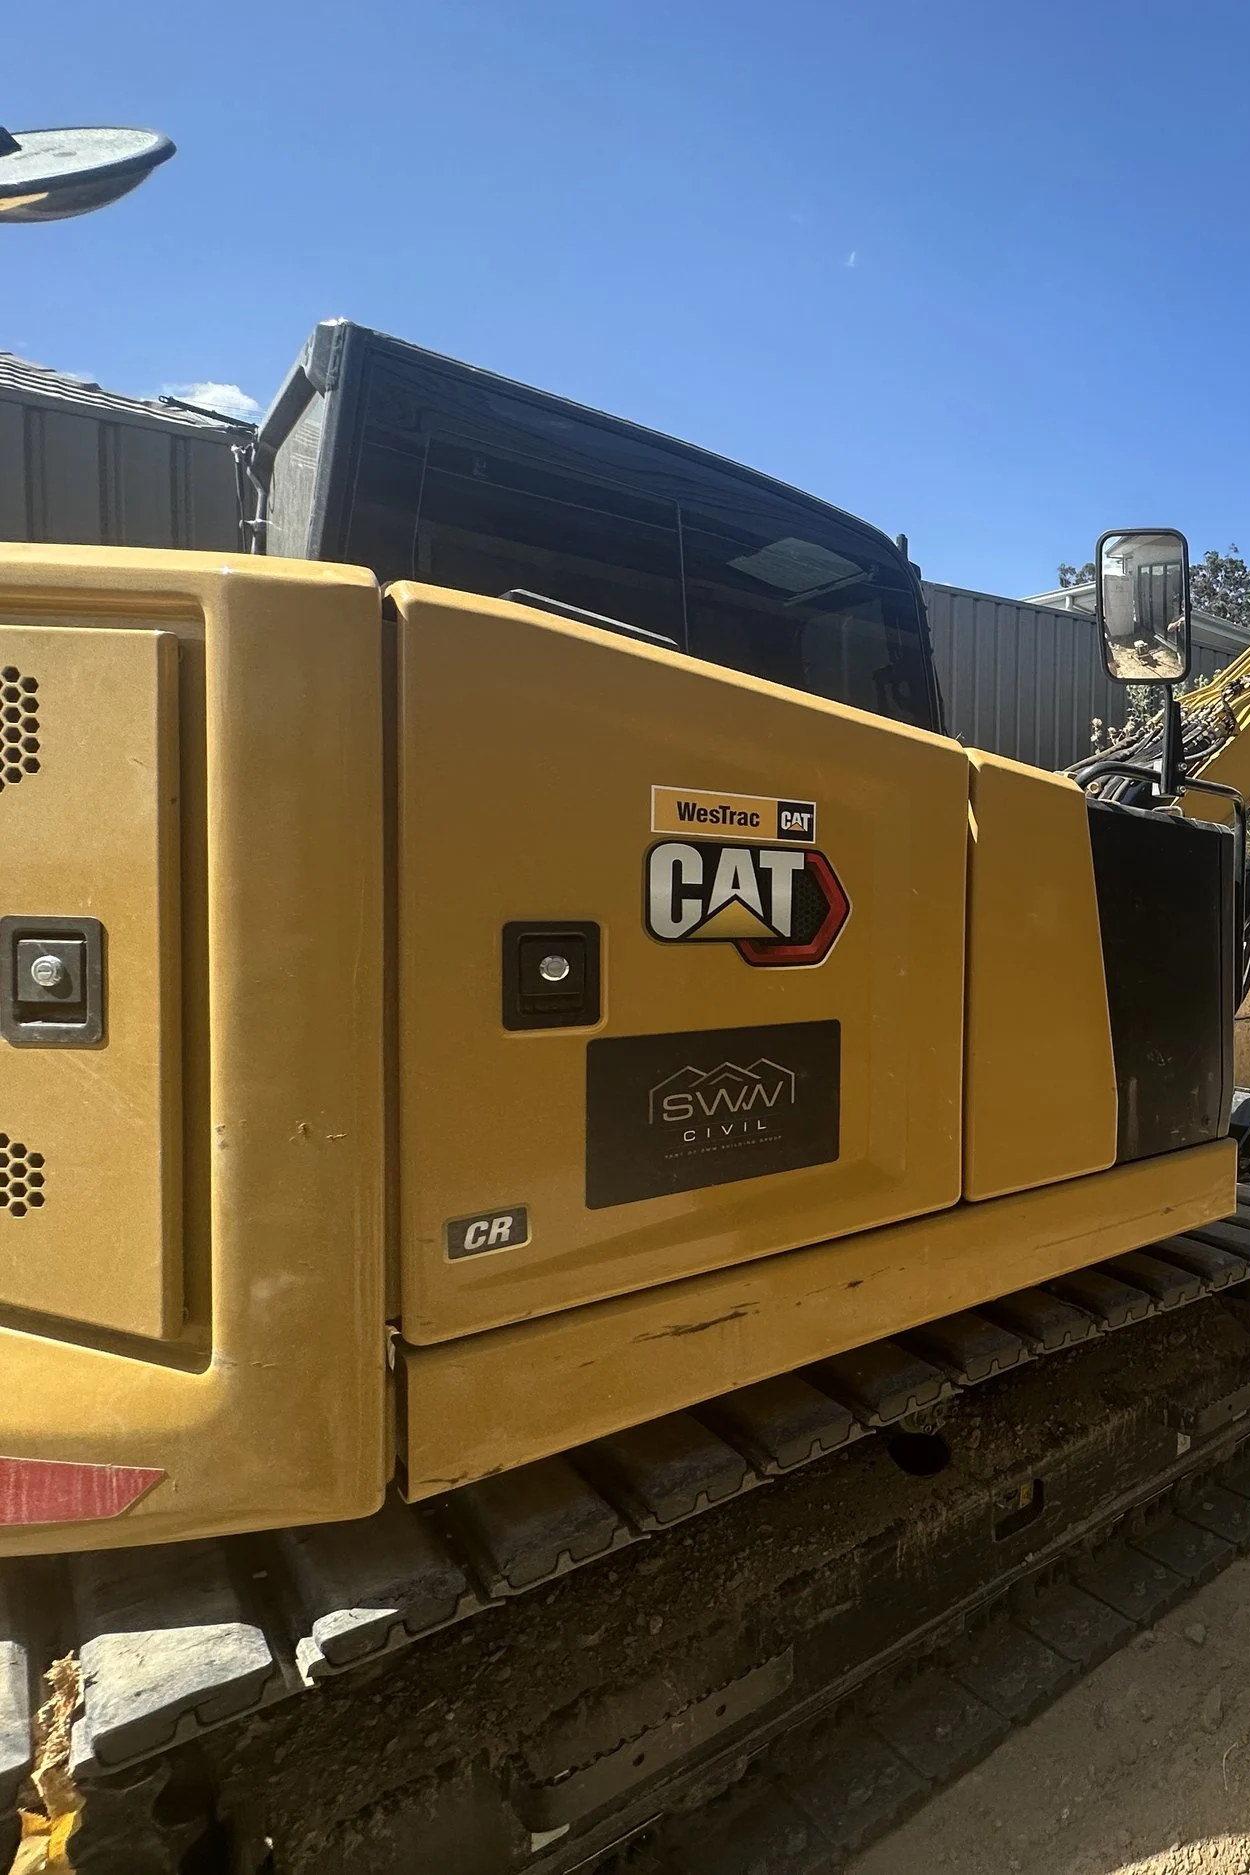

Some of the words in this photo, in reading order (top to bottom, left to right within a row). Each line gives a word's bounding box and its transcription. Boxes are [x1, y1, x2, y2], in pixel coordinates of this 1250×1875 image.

[677, 801, 760, 827] WesTrac
[781, 811, 811, 832] CAT
[650, 843, 805, 939] CAT
[683, 1120, 767, 1142] CIVIL
[464, 1216, 513, 1250] CR
